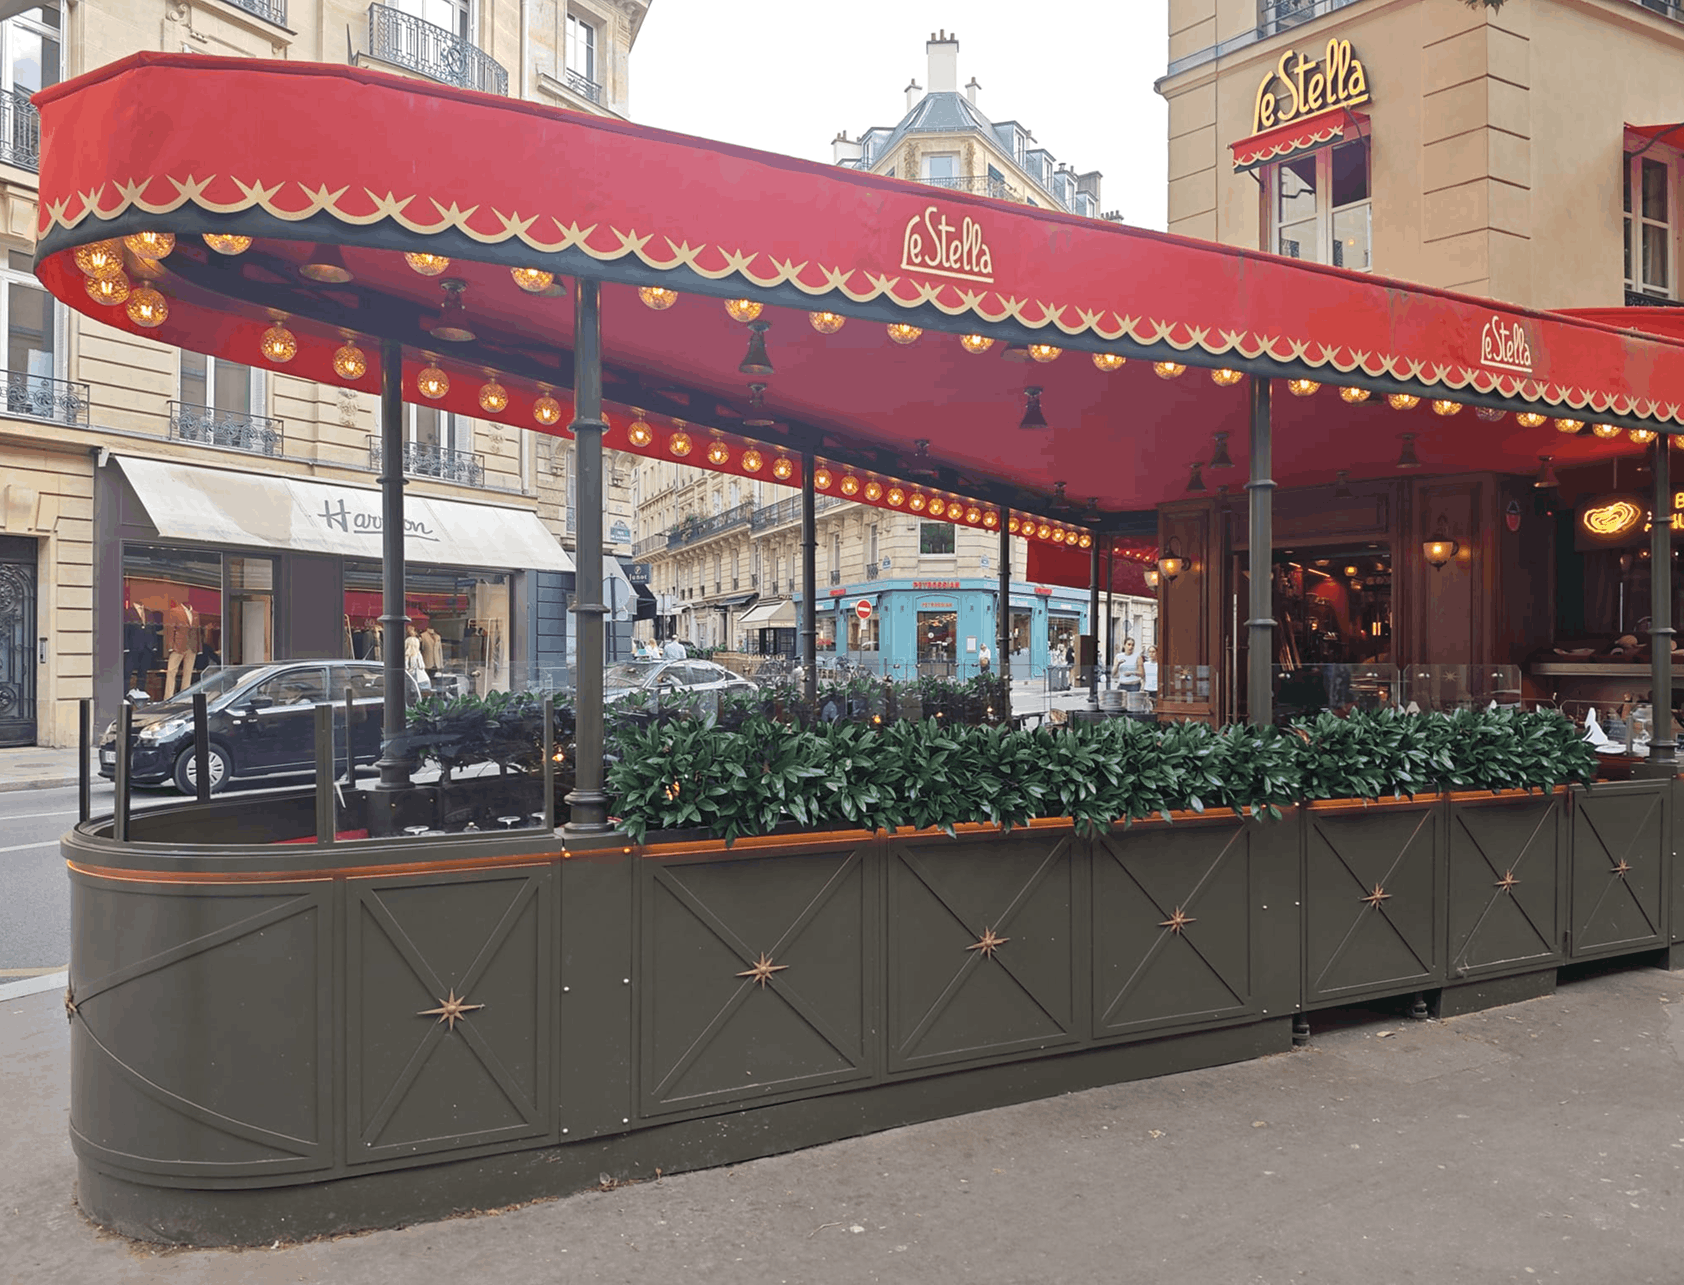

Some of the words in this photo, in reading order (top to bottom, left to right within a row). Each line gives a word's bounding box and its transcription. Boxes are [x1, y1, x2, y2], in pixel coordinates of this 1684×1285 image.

[1277, 38, 1367, 121] Stella
[924, 206, 993, 274] Stella
[1492, 315, 1532, 366] Stella
